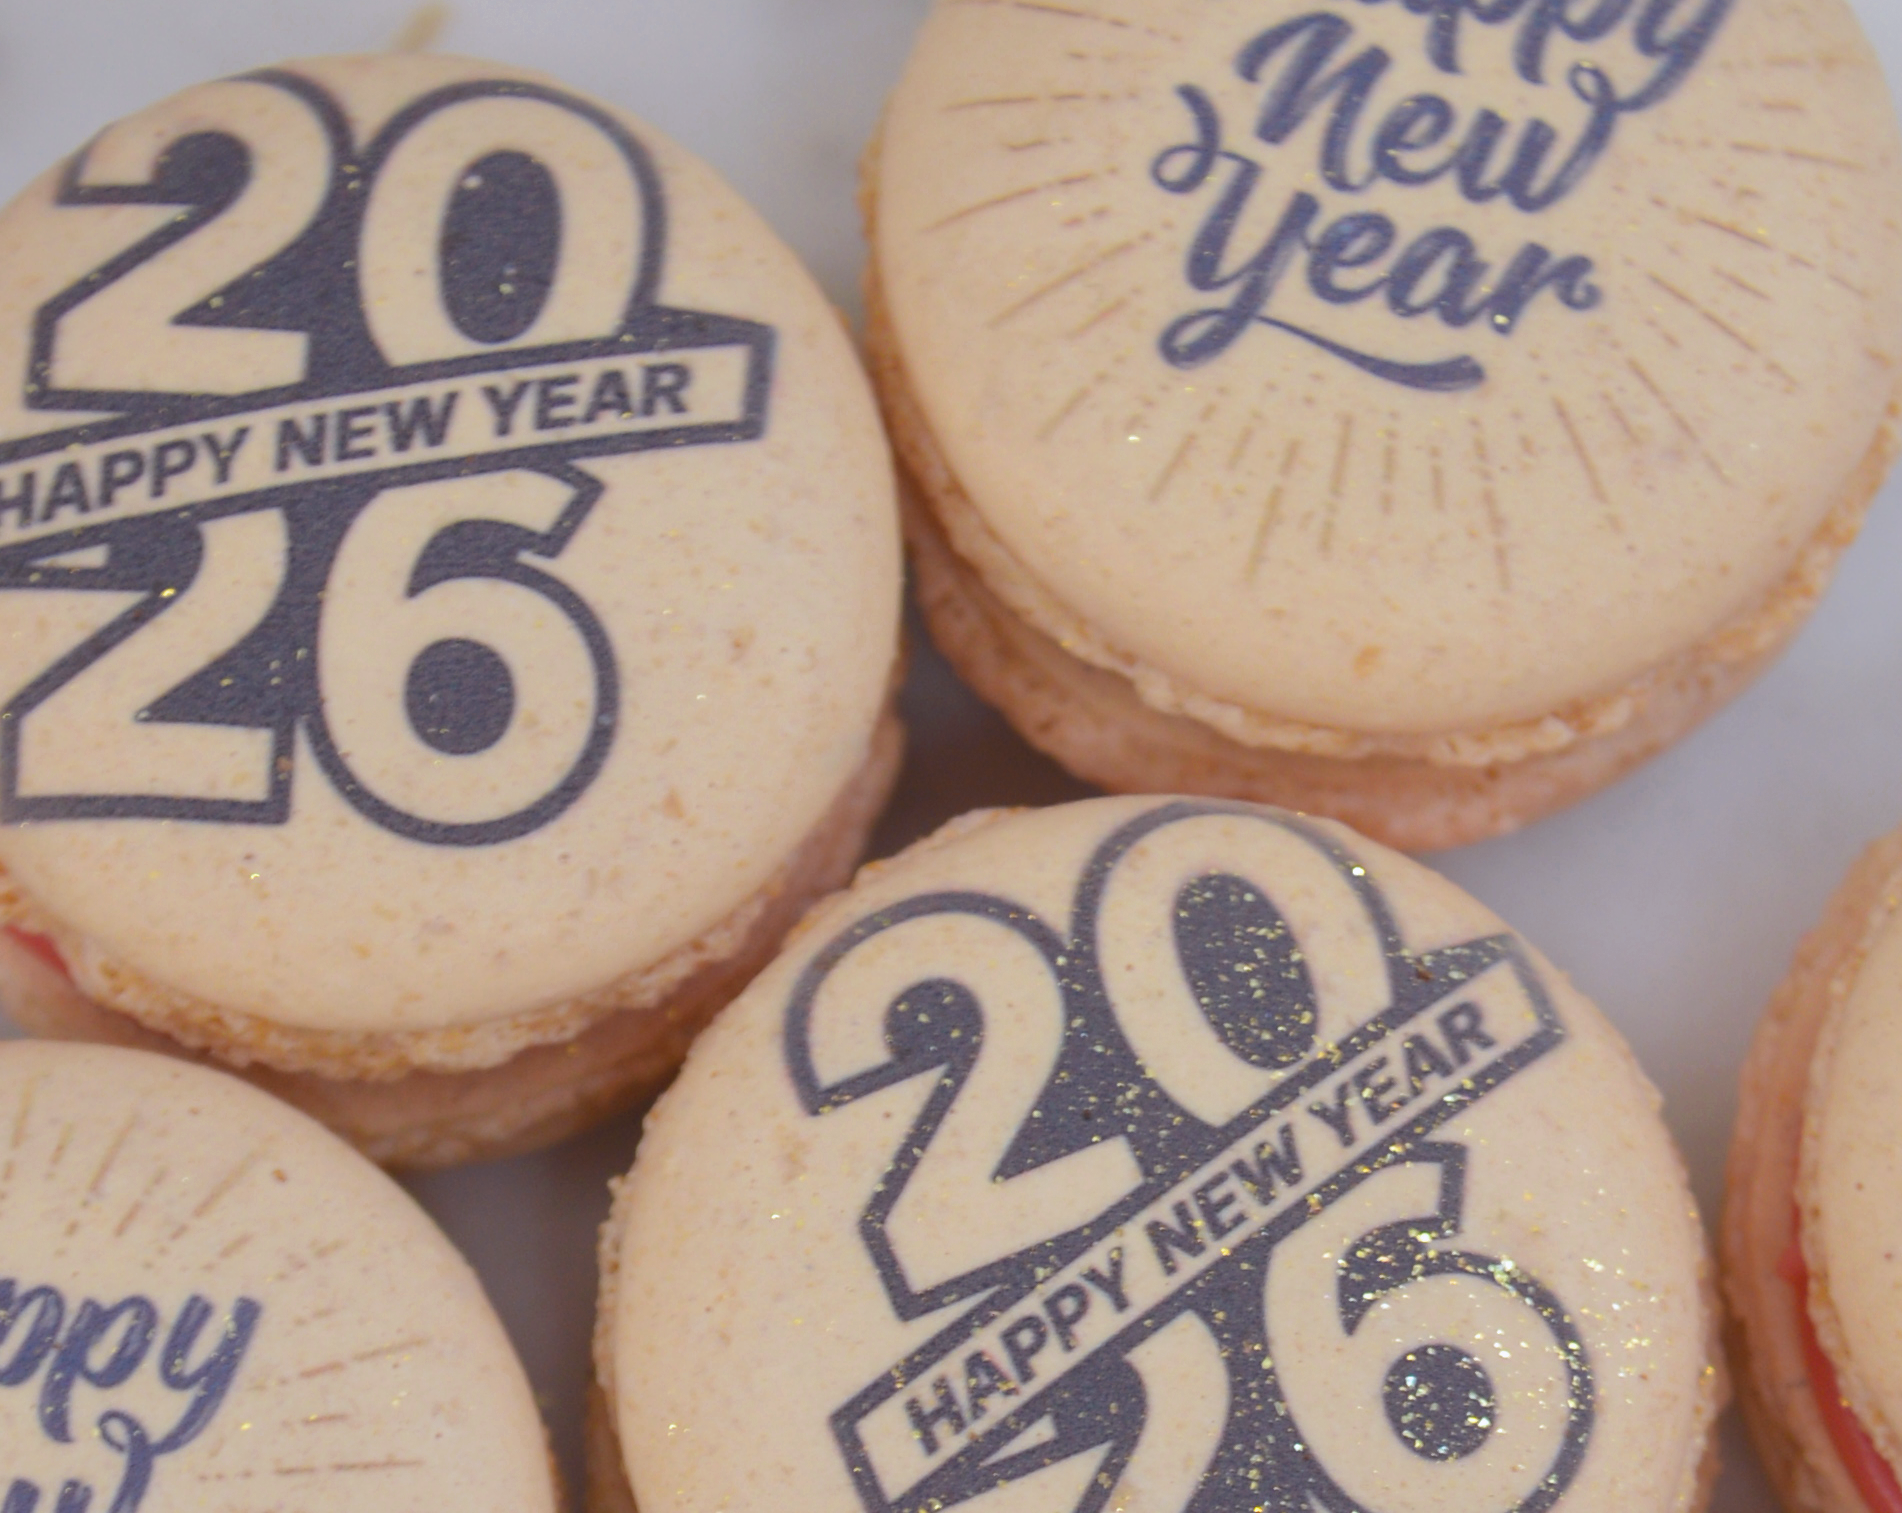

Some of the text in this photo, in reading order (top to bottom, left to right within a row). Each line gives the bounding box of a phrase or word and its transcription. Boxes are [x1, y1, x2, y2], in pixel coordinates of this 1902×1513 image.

[30, 70, 664, 405] 20
[1150, 83, 1602, 392] Year
[1235, 11, 1616, 213] New
[0, 362, 694, 528] HAPPY NEW YEAR
[0, 464, 618, 844] 26
[786, 804, 1395, 1315] 20
[908, 1001, 1496, 1455] HAPPY NEW YEAR
